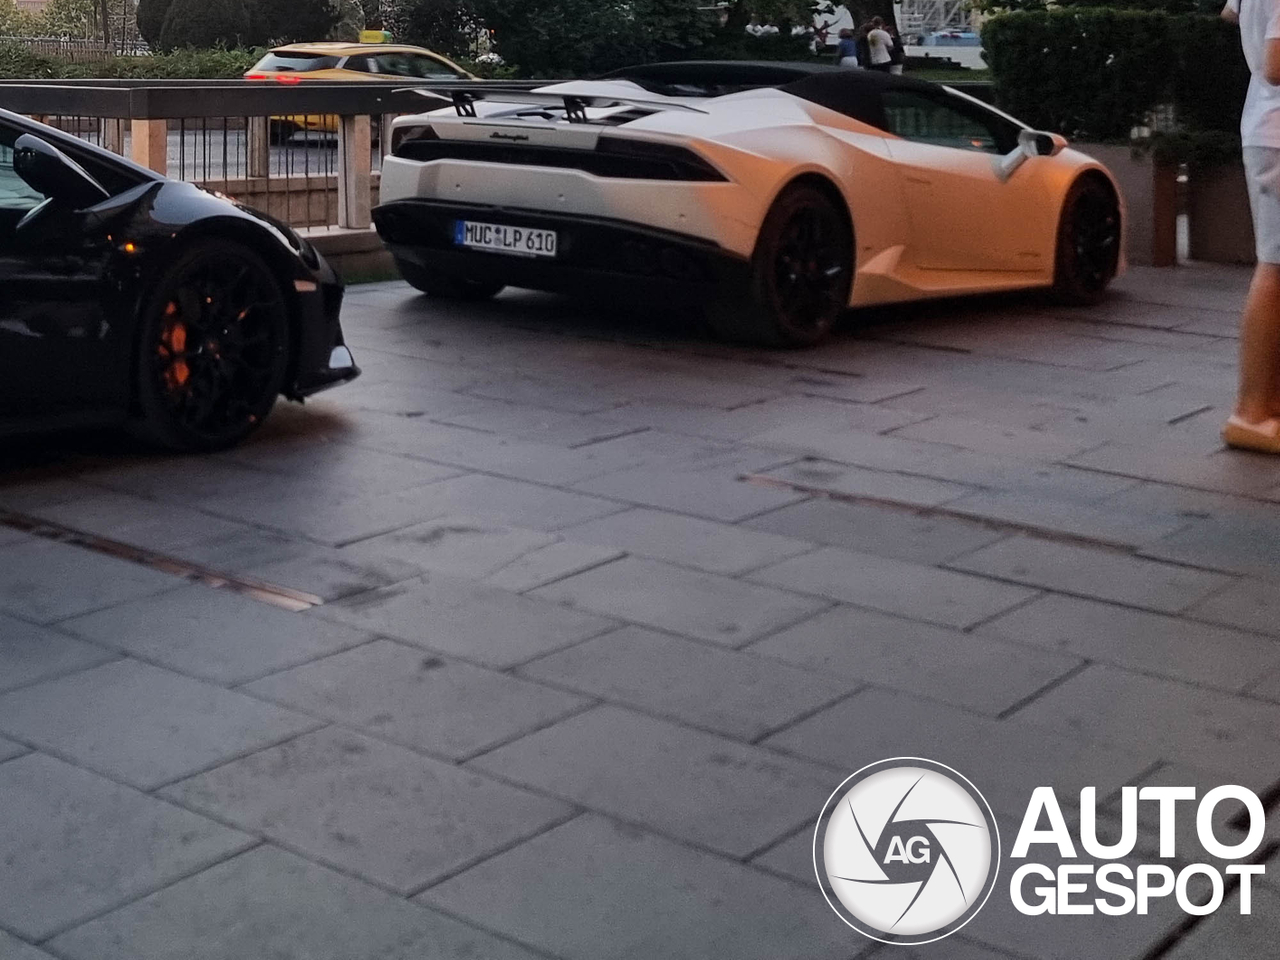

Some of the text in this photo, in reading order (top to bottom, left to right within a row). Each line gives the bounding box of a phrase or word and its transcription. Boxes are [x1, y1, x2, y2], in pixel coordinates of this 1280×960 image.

[465, 224, 554, 253] MUC LP 610
